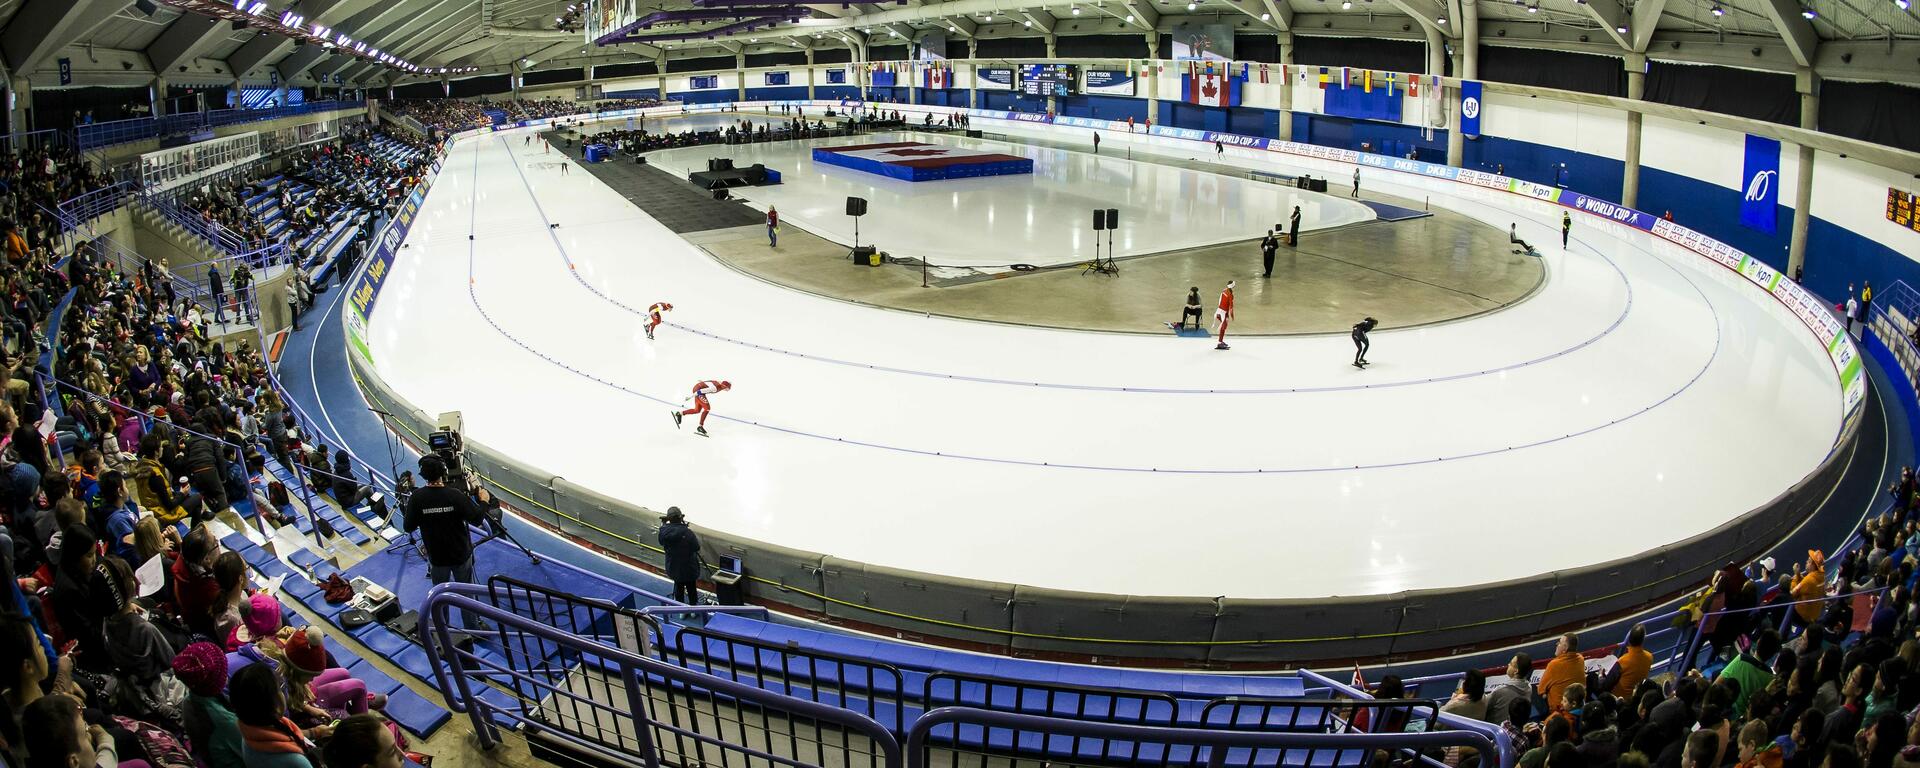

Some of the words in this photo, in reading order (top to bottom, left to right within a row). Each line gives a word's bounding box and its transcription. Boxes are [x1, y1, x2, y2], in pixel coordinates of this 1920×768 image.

[1217, 132, 1239, 144] WORLD
[1240, 136, 1253, 146] CUP
[1363, 154, 1382, 167] DKB
[1393, 159, 1414, 171] DKB
[1426, 165, 1446, 176] DKB
[1532, 185, 1550, 197] kpn
[1585, 198, 1614, 216] WORLD
[1613, 207, 1630, 220] CUP
[1756, 266, 1772, 283] kpn
